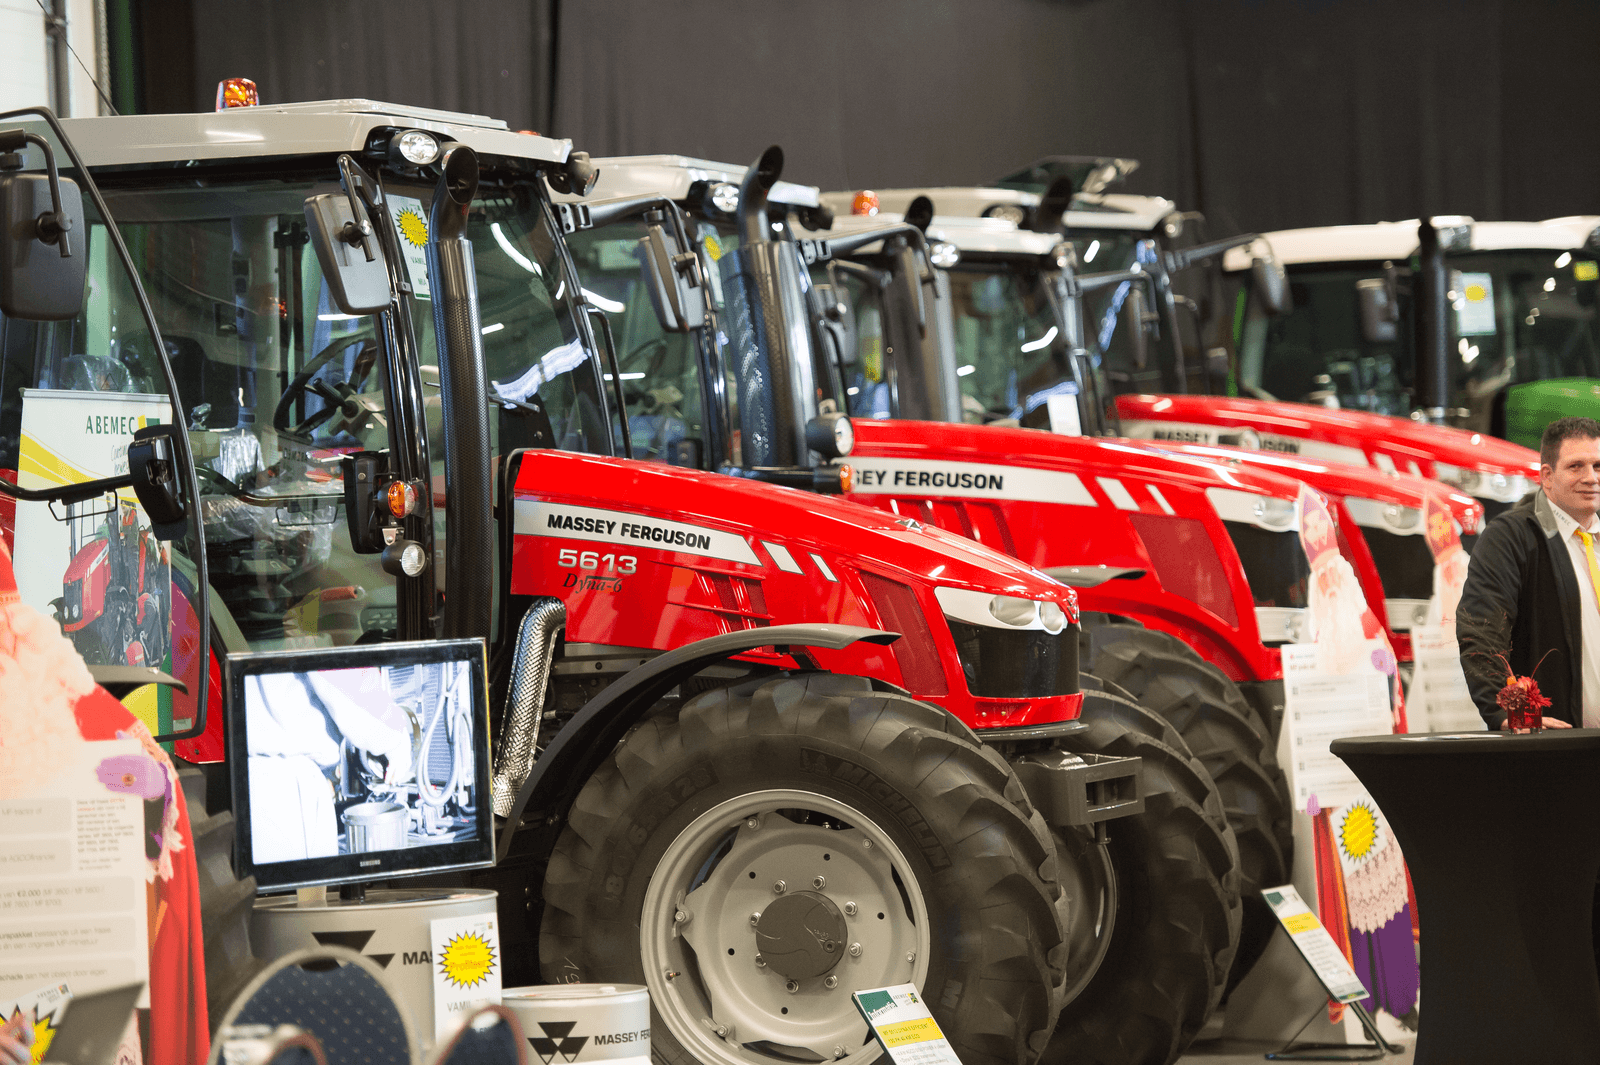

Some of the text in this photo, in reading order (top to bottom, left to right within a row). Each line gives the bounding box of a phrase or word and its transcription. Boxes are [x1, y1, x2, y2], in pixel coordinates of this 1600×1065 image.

[85, 415, 136, 436] ABEMEC
[893, 470, 1004, 490] FERGUSON
[547, 514, 712, 551] MASSEY FERGUSON
[557, 547, 638, 575] 5613
[562, 572, 624, 594] Dyna-6
[833, 760, 952, 869] MICHELIN
[594, 1031, 640, 1046] MASSEY
